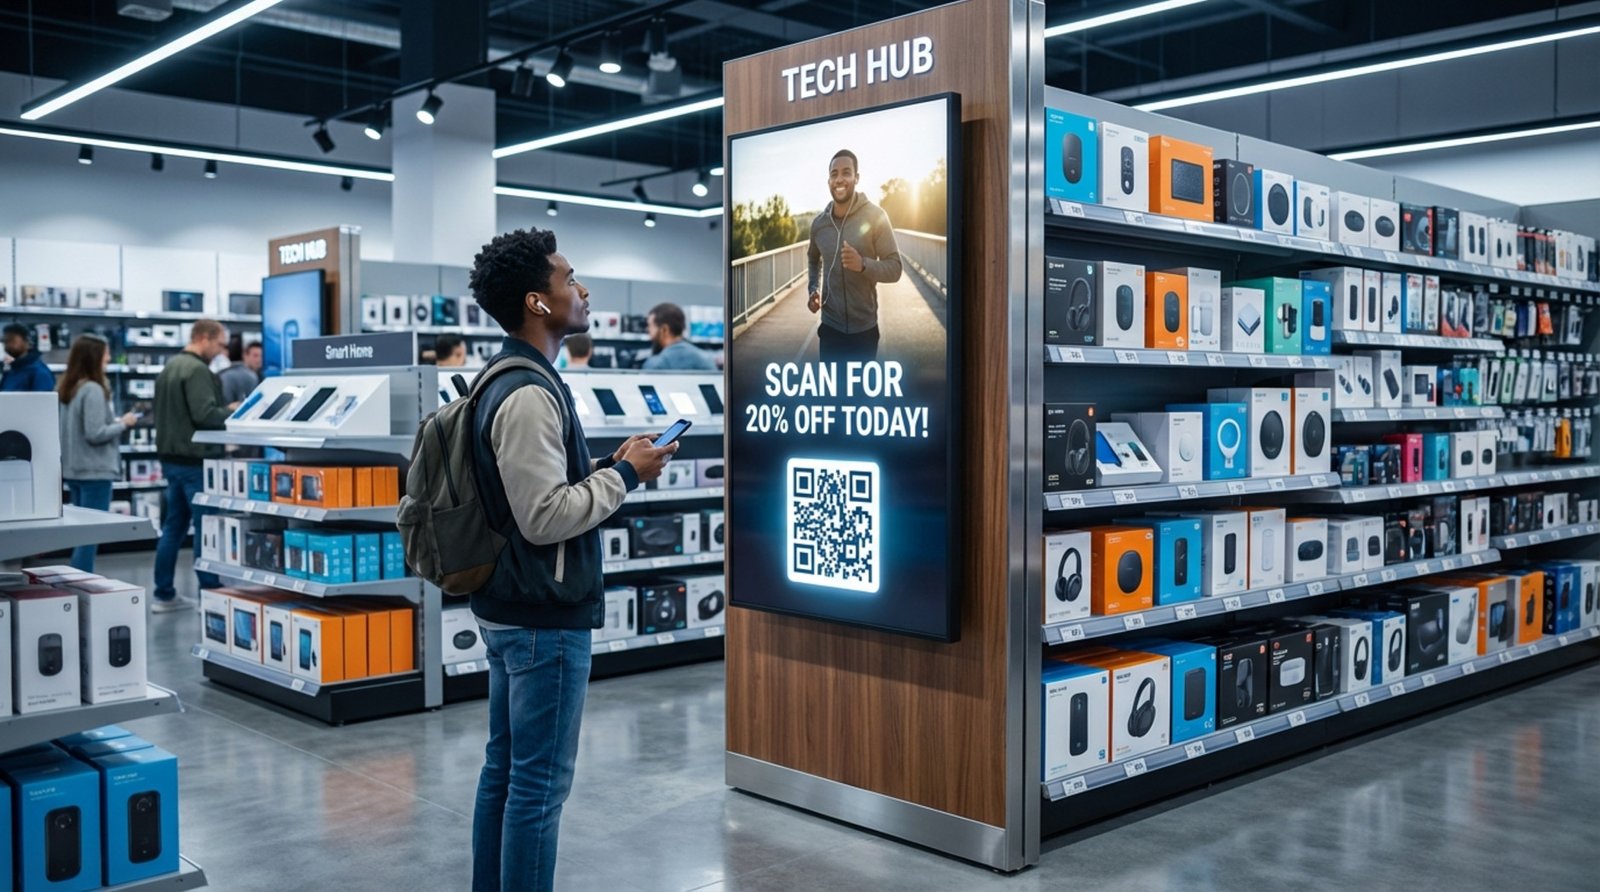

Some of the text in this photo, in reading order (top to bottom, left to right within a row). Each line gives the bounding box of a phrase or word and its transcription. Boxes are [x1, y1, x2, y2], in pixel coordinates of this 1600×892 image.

[781, 36, 934, 102] TECH HUB
[279, 239, 327, 264] TECH HUB
[325, 343, 374, 360] Smart Home
[765, 360, 904, 398] SCAN FOR
[746, 404, 929, 438] 20% OFF TODAY!
